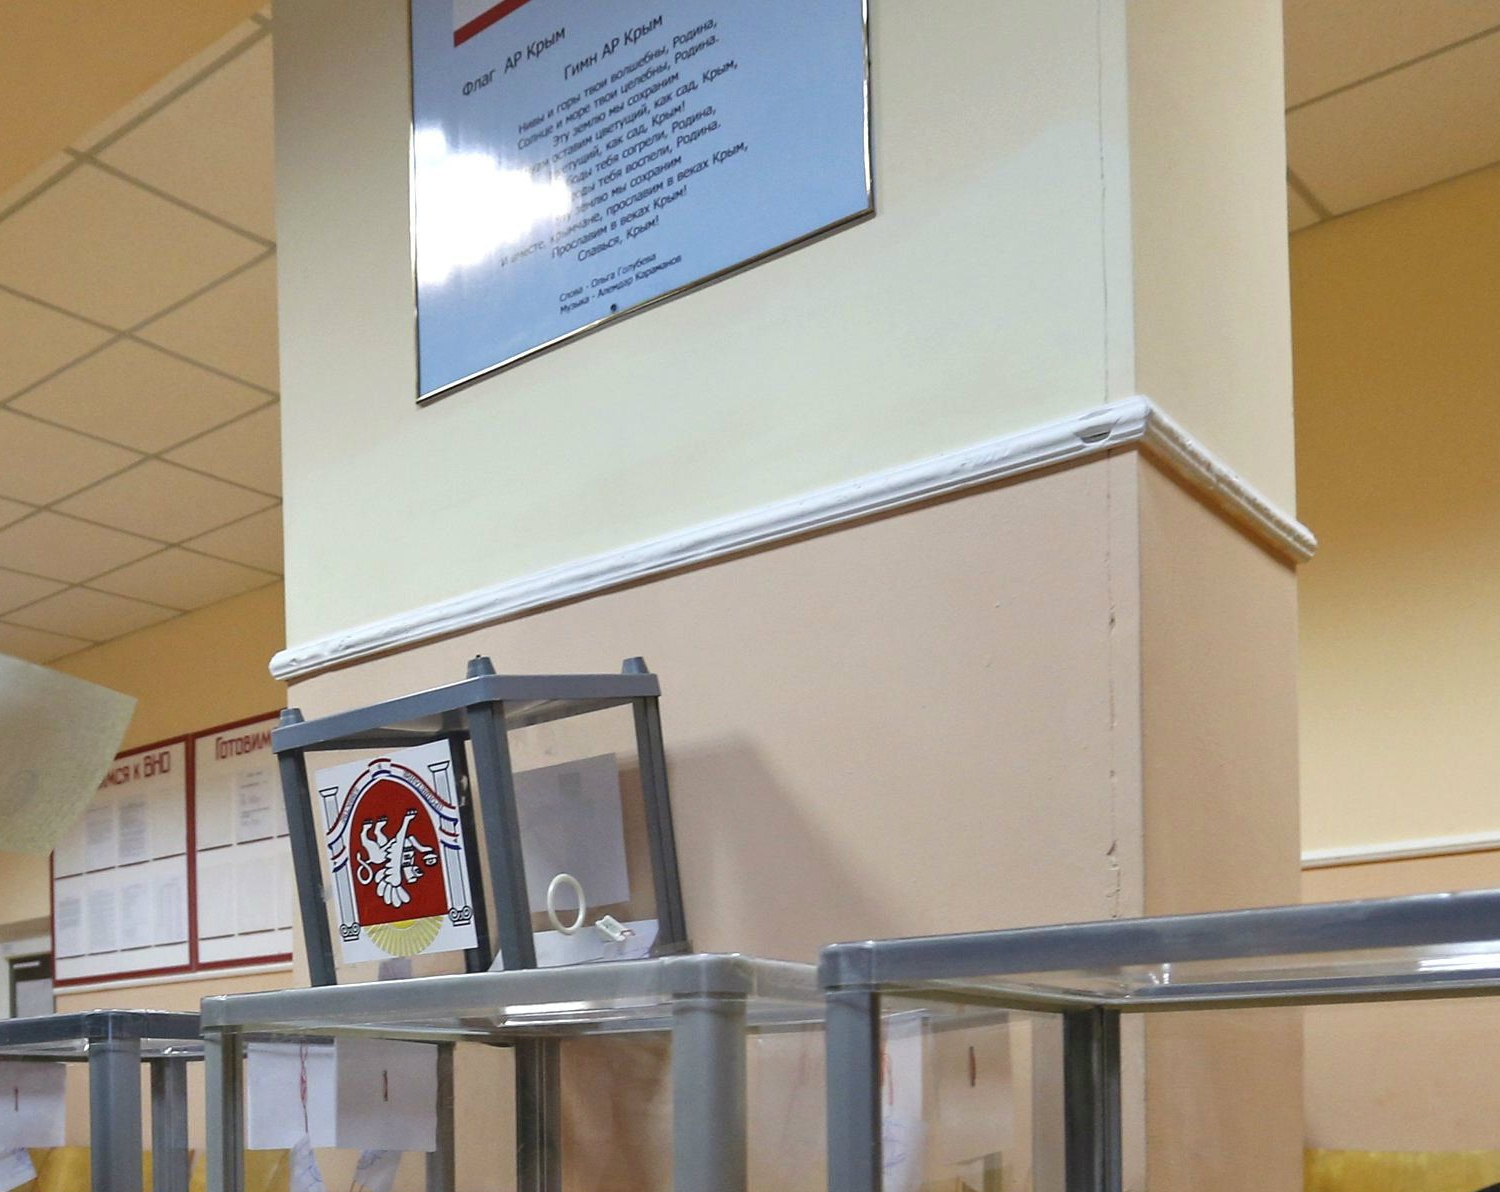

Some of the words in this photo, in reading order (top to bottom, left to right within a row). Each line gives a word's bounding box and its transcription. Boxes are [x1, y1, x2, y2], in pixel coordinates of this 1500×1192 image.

[462, 69, 497, 97] Флаг
[504, 51, 522, 74] АР
[527, 27, 566, 61] Крым
[519, 114, 545, 133] Нивы
[547, 109, 554, 118] и
[557, 94, 581, 113] горы
[584, 78, 608, 97] твои
[611, 46, 669, 83] волшебны,
[673, 19, 717, 49] Родина,
[564, 55, 598, 80] Гимн
[602, 37, 621, 60] АР
[624, 15, 663, 46] Крым
[518, 125, 553, 150] Солнце
[556, 120, 563, 129] и
[566, 104, 590, 124] море
[594, 90, 617, 108] твои
[621, 62, 671, 94] целебны,
[675, 35, 719, 64] Родина.
[552, 136, 592, 163] оставим
[596, 104, 651, 140] цветущий,
[654, 92, 673, 108] как
[676, 80, 698, 97] сад,
[703, 60, 738, 83] Крым,
[553, 131, 570, 148] Эту
[573, 113, 606, 136] землю
[609, 102, 624, 116] мы
[628, 72, 679, 106] сохраним
[606, 136, 623, 151] как
[626, 124, 648, 140] сад,
[652, 100, 685, 127] Крым!
[596, 154, 619, 172] тебя
[622, 130, 668, 158] согрели,
[672, 105, 716, 133] Родина,
[598, 169, 622, 186] тебя
[625, 145, 672, 174] воспели,
[677, 120, 721, 148] Родина.
[606, 182, 663, 216] прославим
[667, 177, 674, 186] в
[677, 160, 709, 181] веках
[712, 142, 748, 164] Крым,
[611, 183, 627, 198] мы
[630, 155, 681, 187] сохраним
[552, 226, 607, 259] Прославим
[610, 220, 617, 230] в
[620, 206, 650, 226] веках
[653, 185, 687, 210] Крым!
[578, 236, 623, 262] Славься,
[626, 214, 659, 239] Крым!
[560, 286, 583, 302] Слова
[591, 272, 615, 288] Ольга
[144, 751, 171, 777] ВНО
